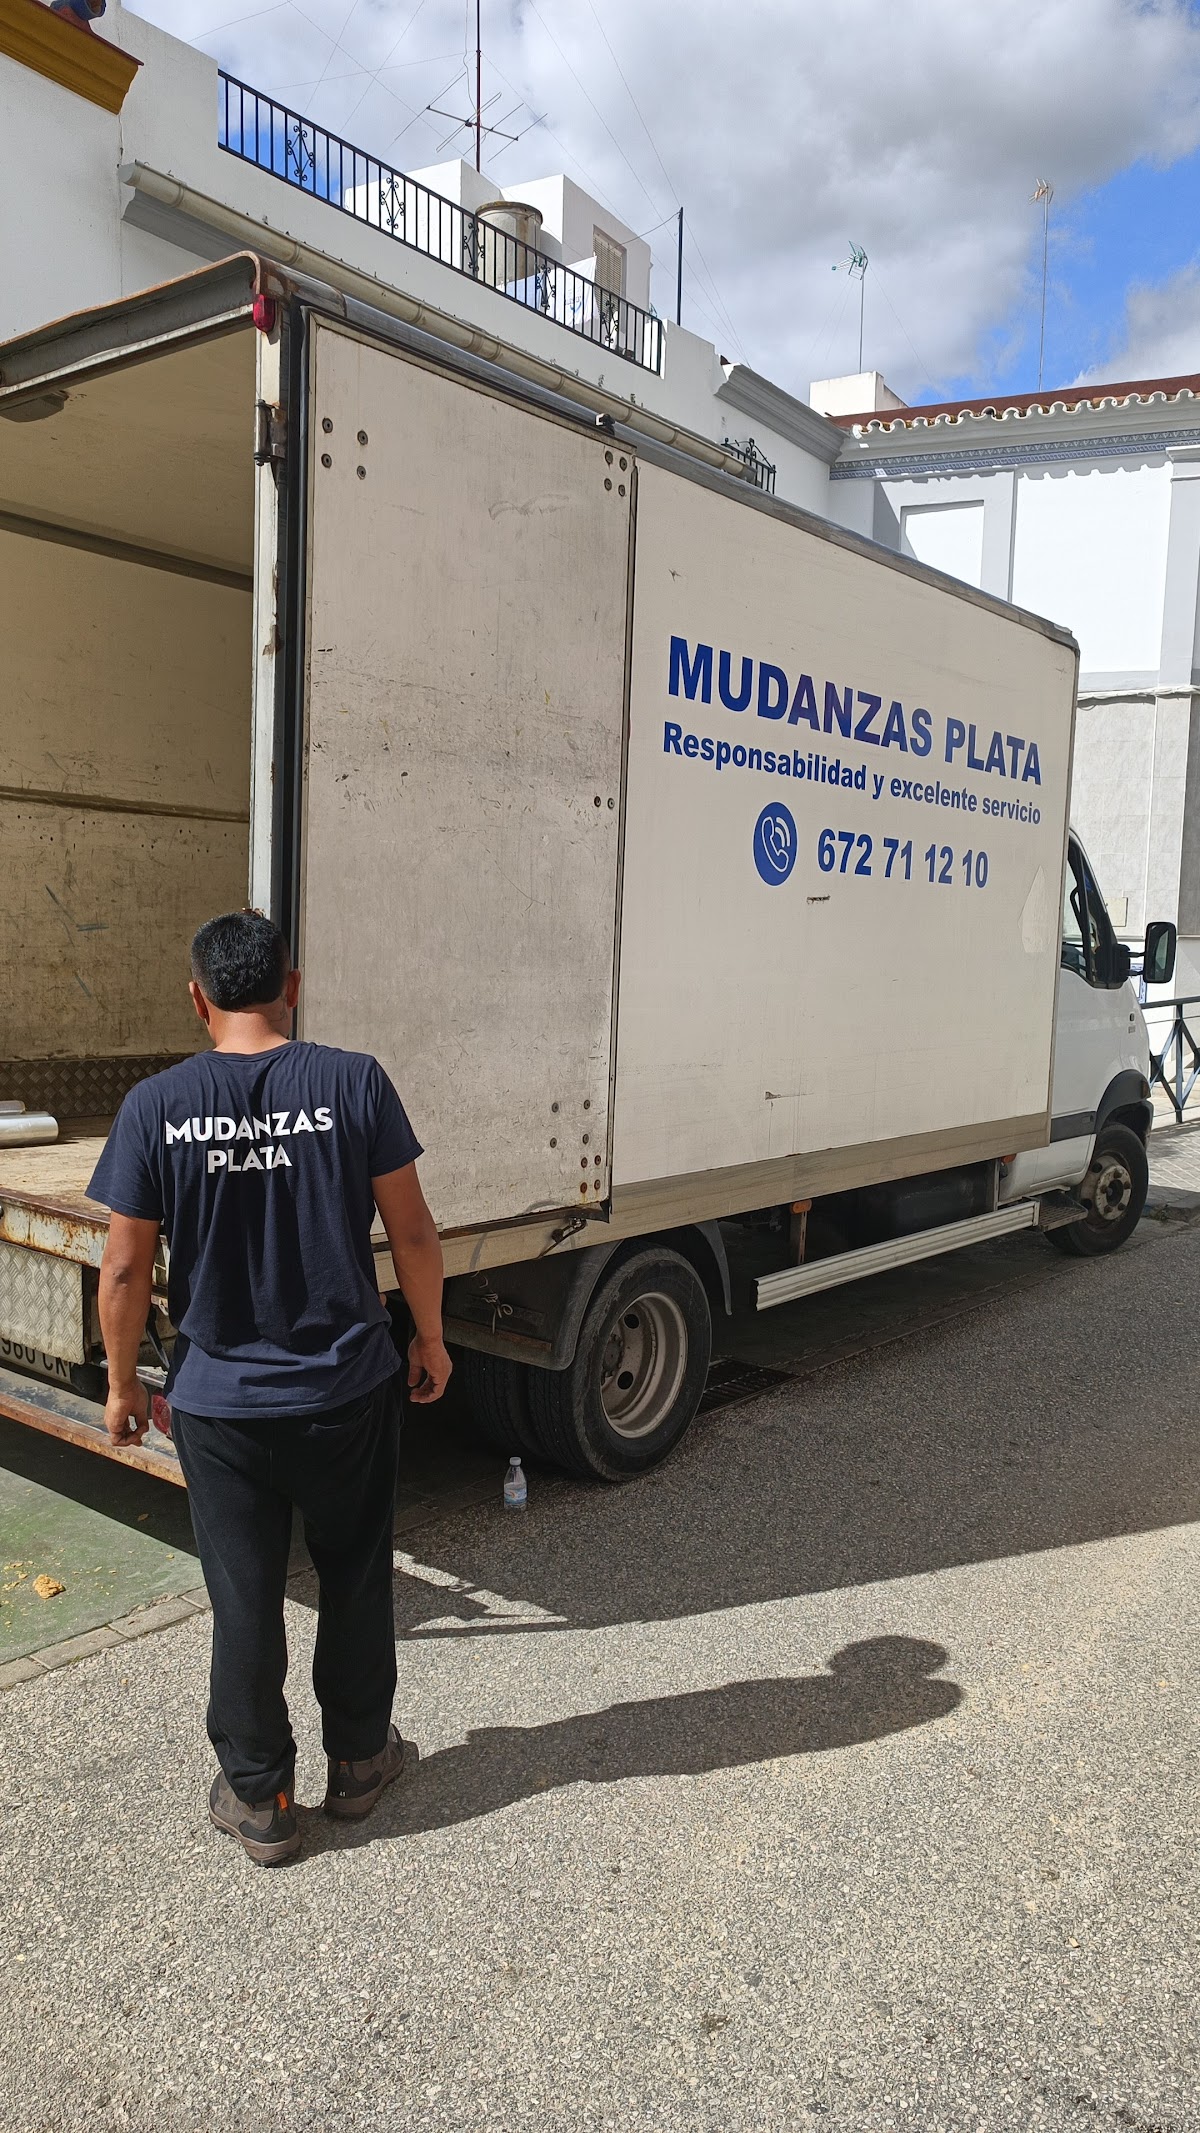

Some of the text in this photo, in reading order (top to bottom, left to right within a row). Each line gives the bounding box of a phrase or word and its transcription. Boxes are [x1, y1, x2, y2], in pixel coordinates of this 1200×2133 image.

[668, 635, 1042, 785] MUDANZAS PLATA
[664, 721, 1042, 825] Responsabilidad y excelente servicio
[818, 828, 988, 888] 672 71 12 10
[165, 1107, 334, 1145] MUDANZAS
[207, 1144, 292, 1174] PLATA
